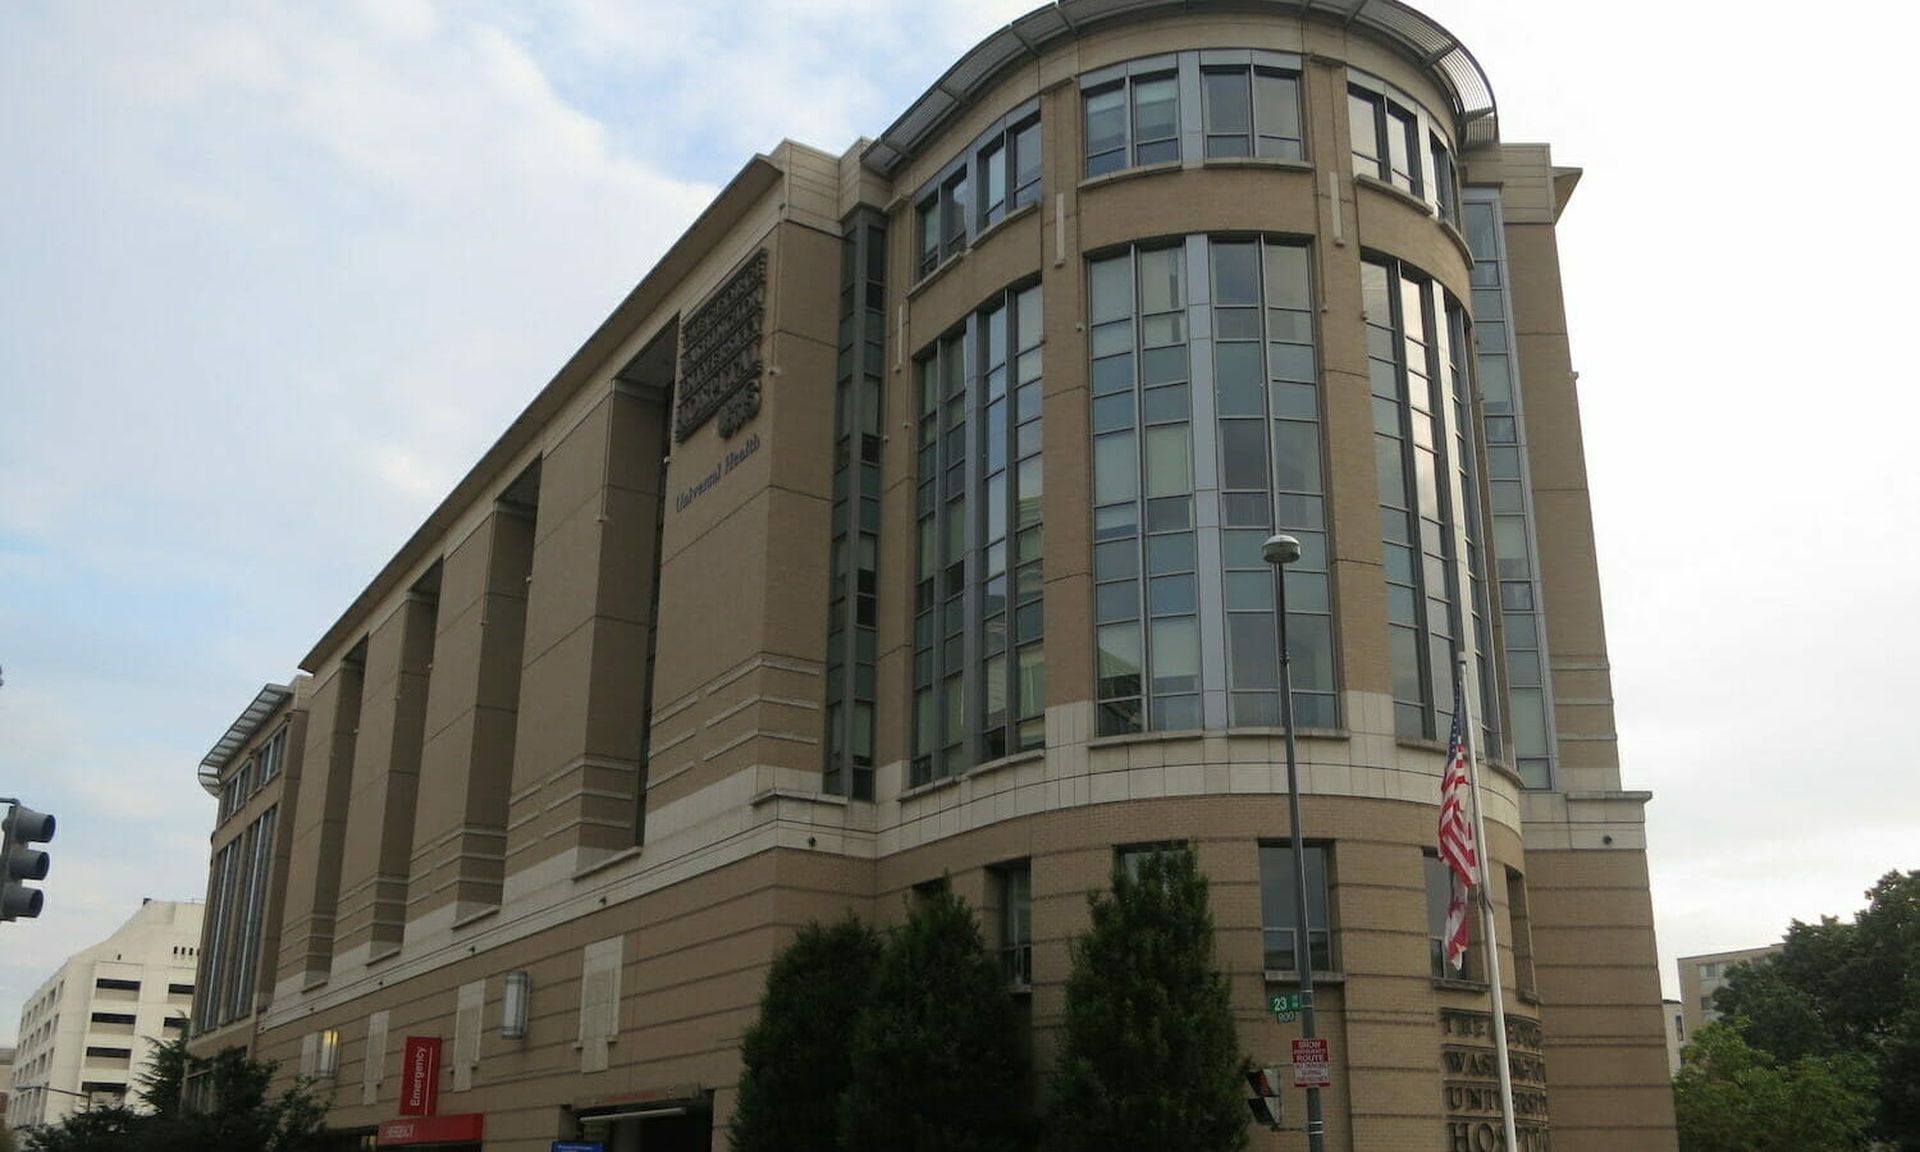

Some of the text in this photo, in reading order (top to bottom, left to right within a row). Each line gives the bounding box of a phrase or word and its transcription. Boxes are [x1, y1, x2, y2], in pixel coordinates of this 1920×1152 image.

[675, 432, 761, 514] Universal Health
[1274, 996, 1288, 1011] 23
[1441, 1012, 1487, 1037] THE
[410, 1046, 427, 1107] Emergency
